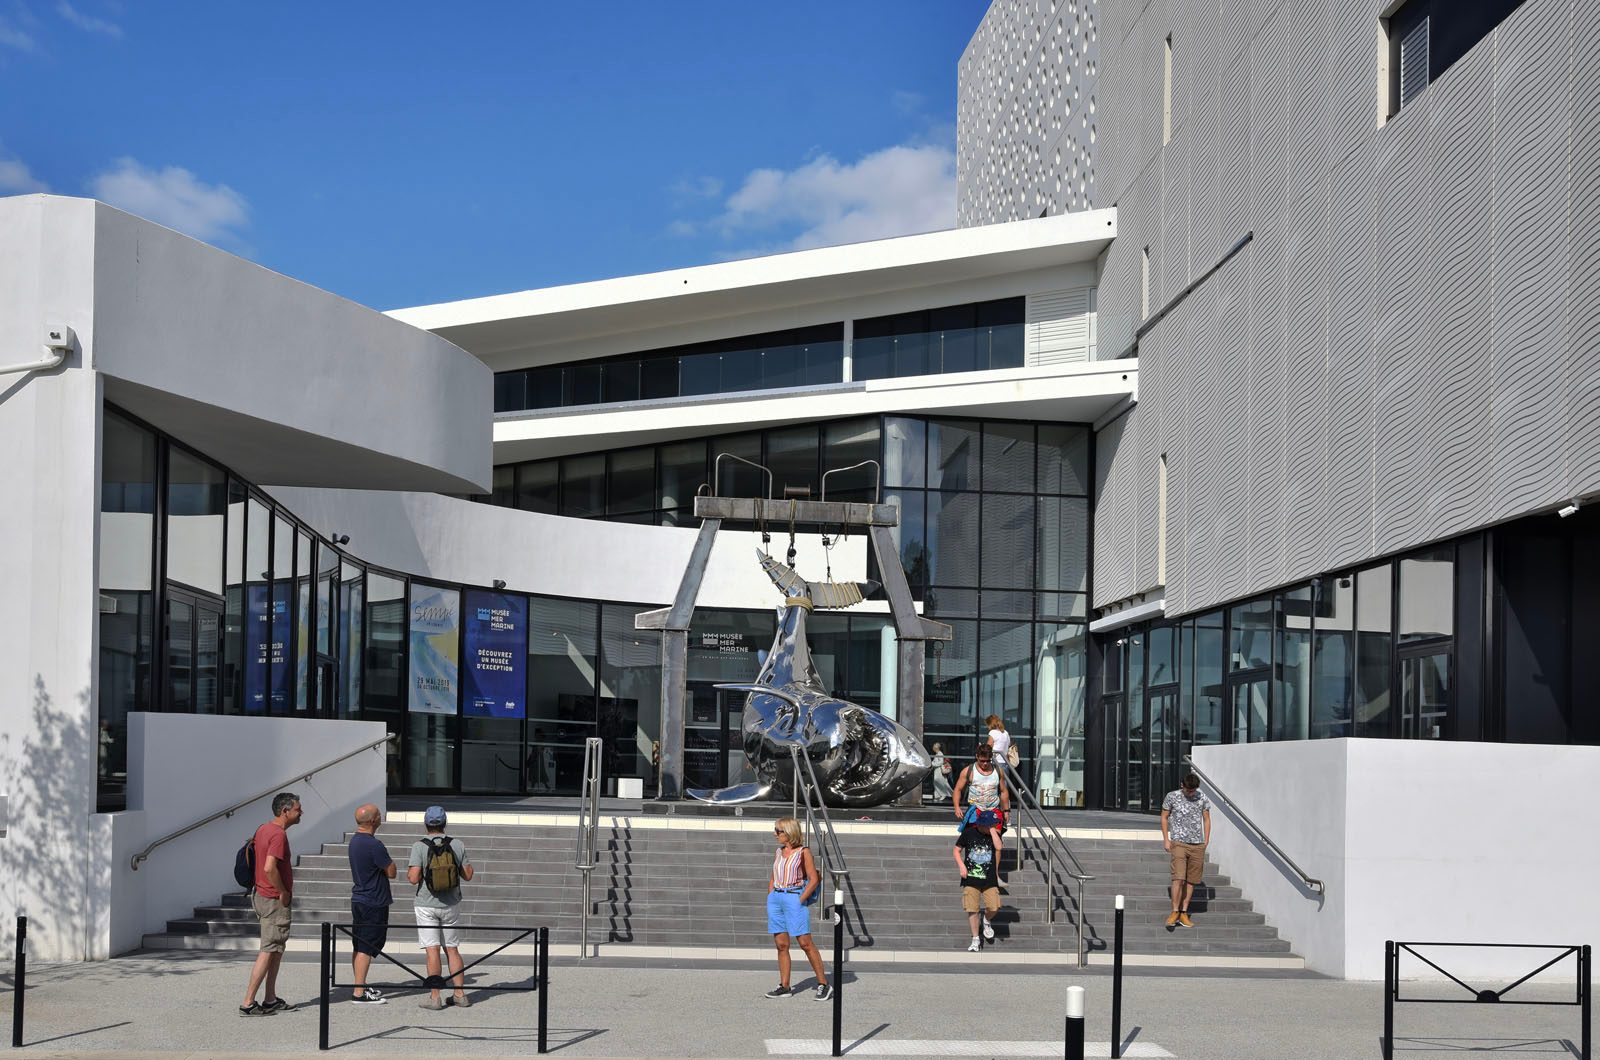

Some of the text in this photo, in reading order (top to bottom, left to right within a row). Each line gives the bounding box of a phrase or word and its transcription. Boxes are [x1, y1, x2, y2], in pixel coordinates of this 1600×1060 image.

[491, 622, 514, 630] MARINE
[478, 649, 512, 658] DÉCOUVREZ
[477, 664, 513, 672] D'EXCEPTION
